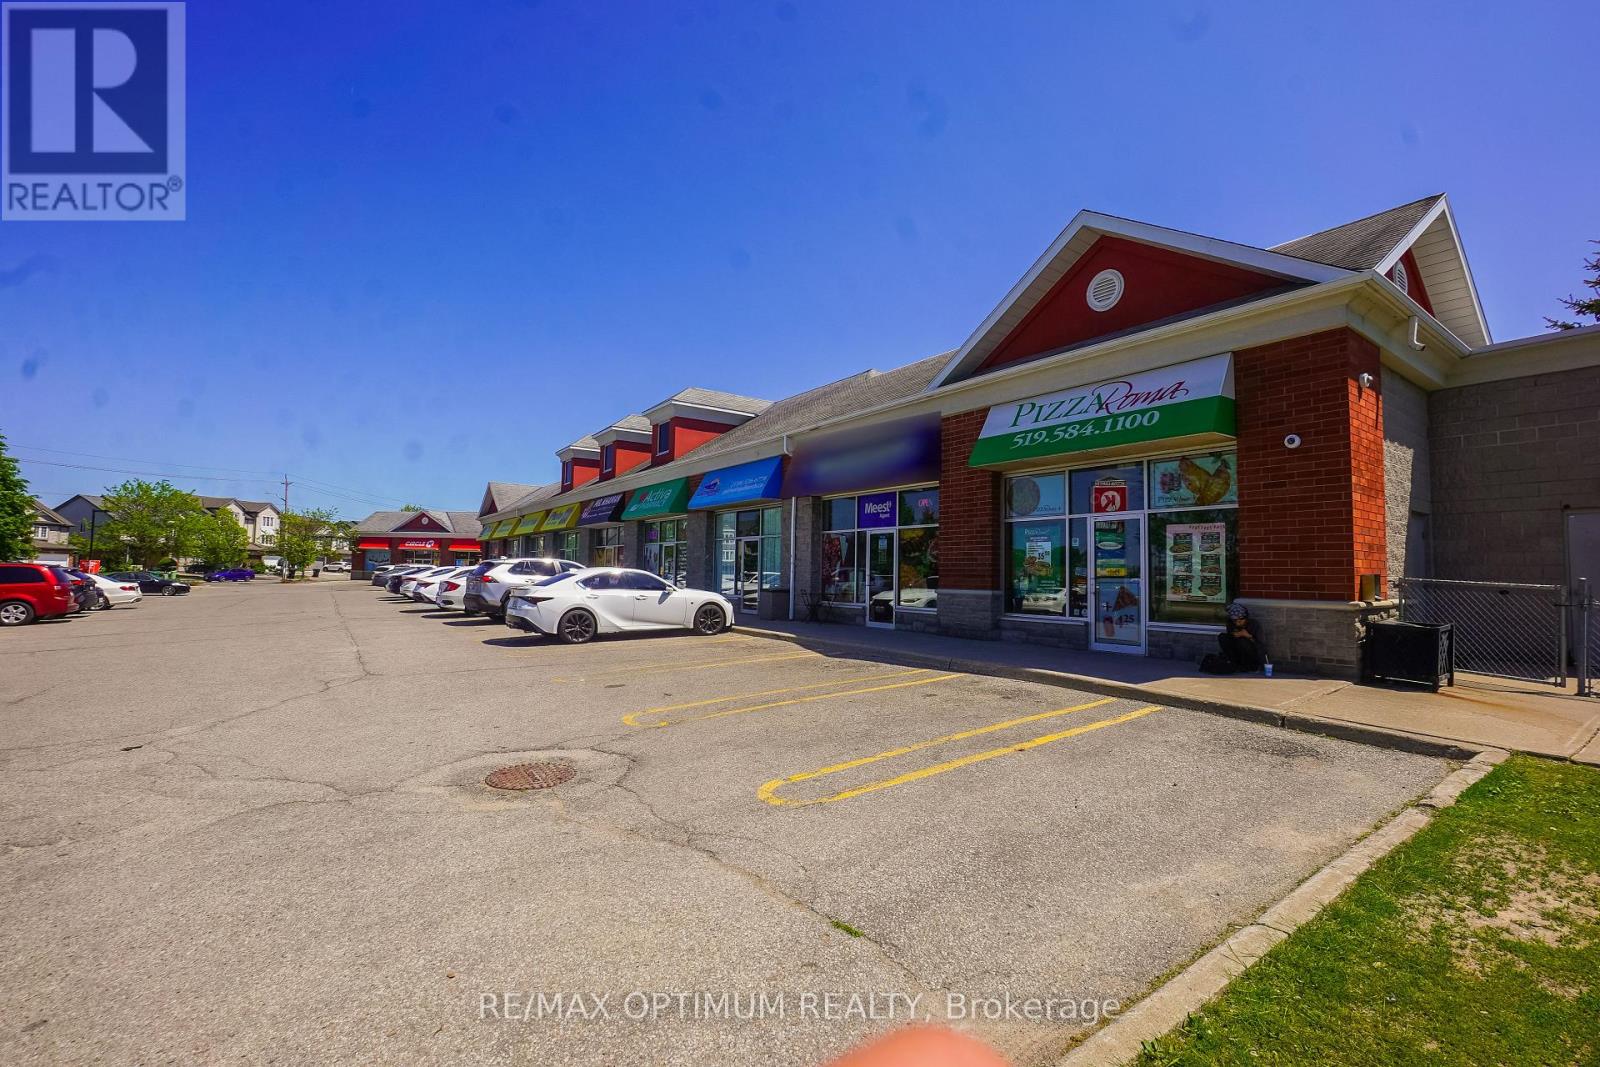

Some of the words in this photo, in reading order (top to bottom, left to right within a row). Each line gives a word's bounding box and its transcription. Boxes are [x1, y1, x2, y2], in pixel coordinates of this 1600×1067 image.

[1008, 391, 1105, 428] PIZZA
[1091, 380, 1189, 415] Roma
[1009, 410, 1160, 450] 519.584.1100
